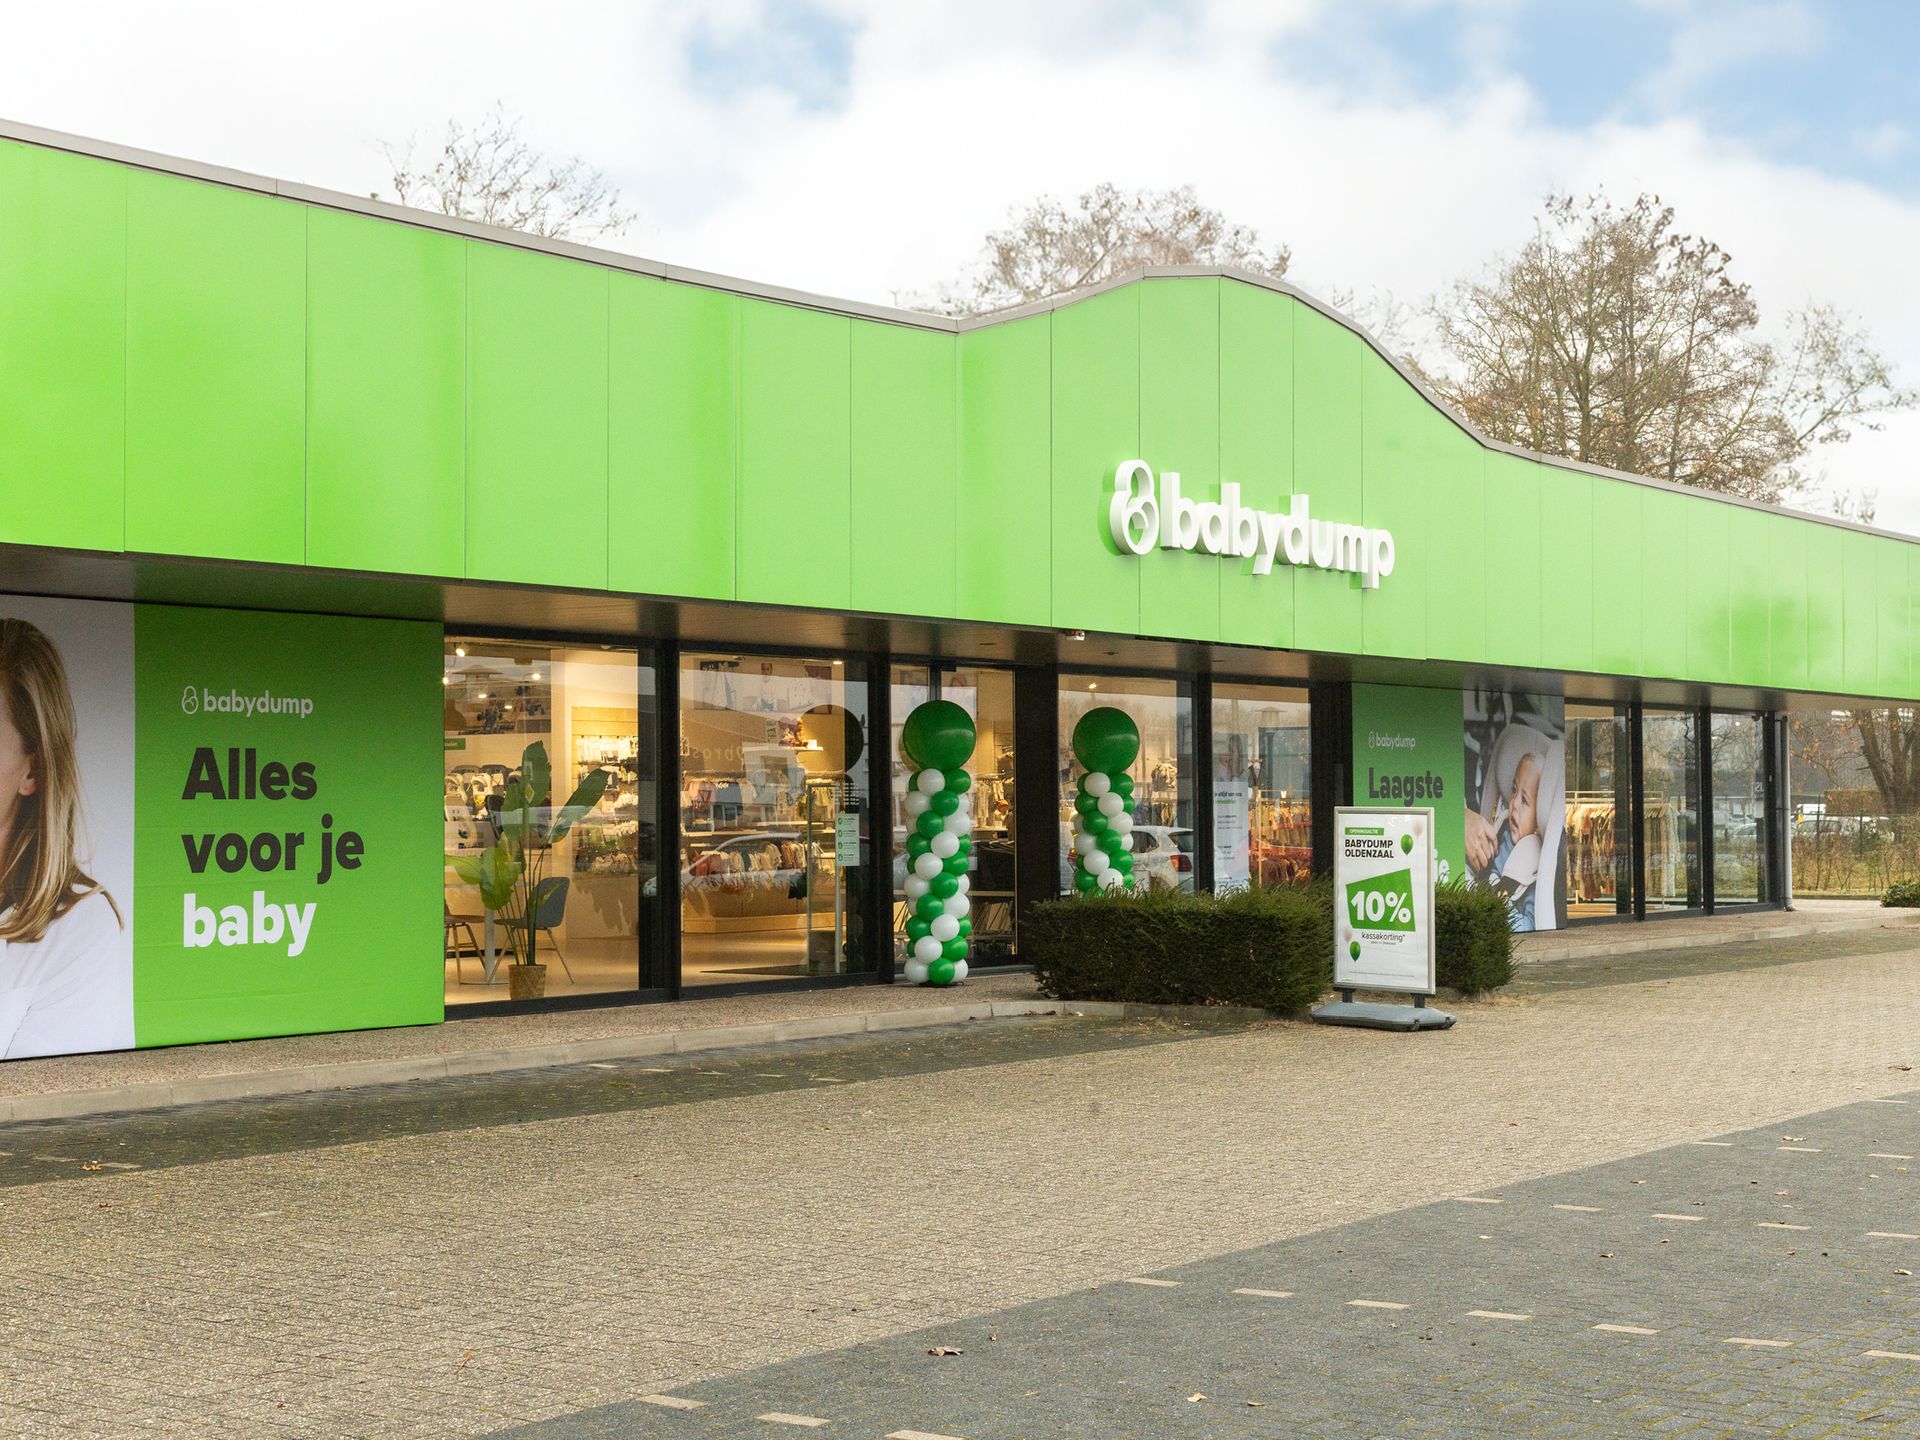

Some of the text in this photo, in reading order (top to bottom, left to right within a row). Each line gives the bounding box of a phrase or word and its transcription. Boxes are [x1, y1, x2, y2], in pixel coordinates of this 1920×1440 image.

[1160, 471, 1395, 590] babydump
[204, 688, 314, 719] babydump
[1375, 733, 1416, 750] babydump
[182, 747, 318, 800] Alles
[1368, 767, 1444, 807] Laagste
[182, 813, 365, 884] voor je
[1345, 839, 1394, 848] BABYDUMP
[1345, 849, 1394, 858] OLDENZAAL
[183, 891, 317, 957] baby
[1351, 891, 1411, 923] 10%
